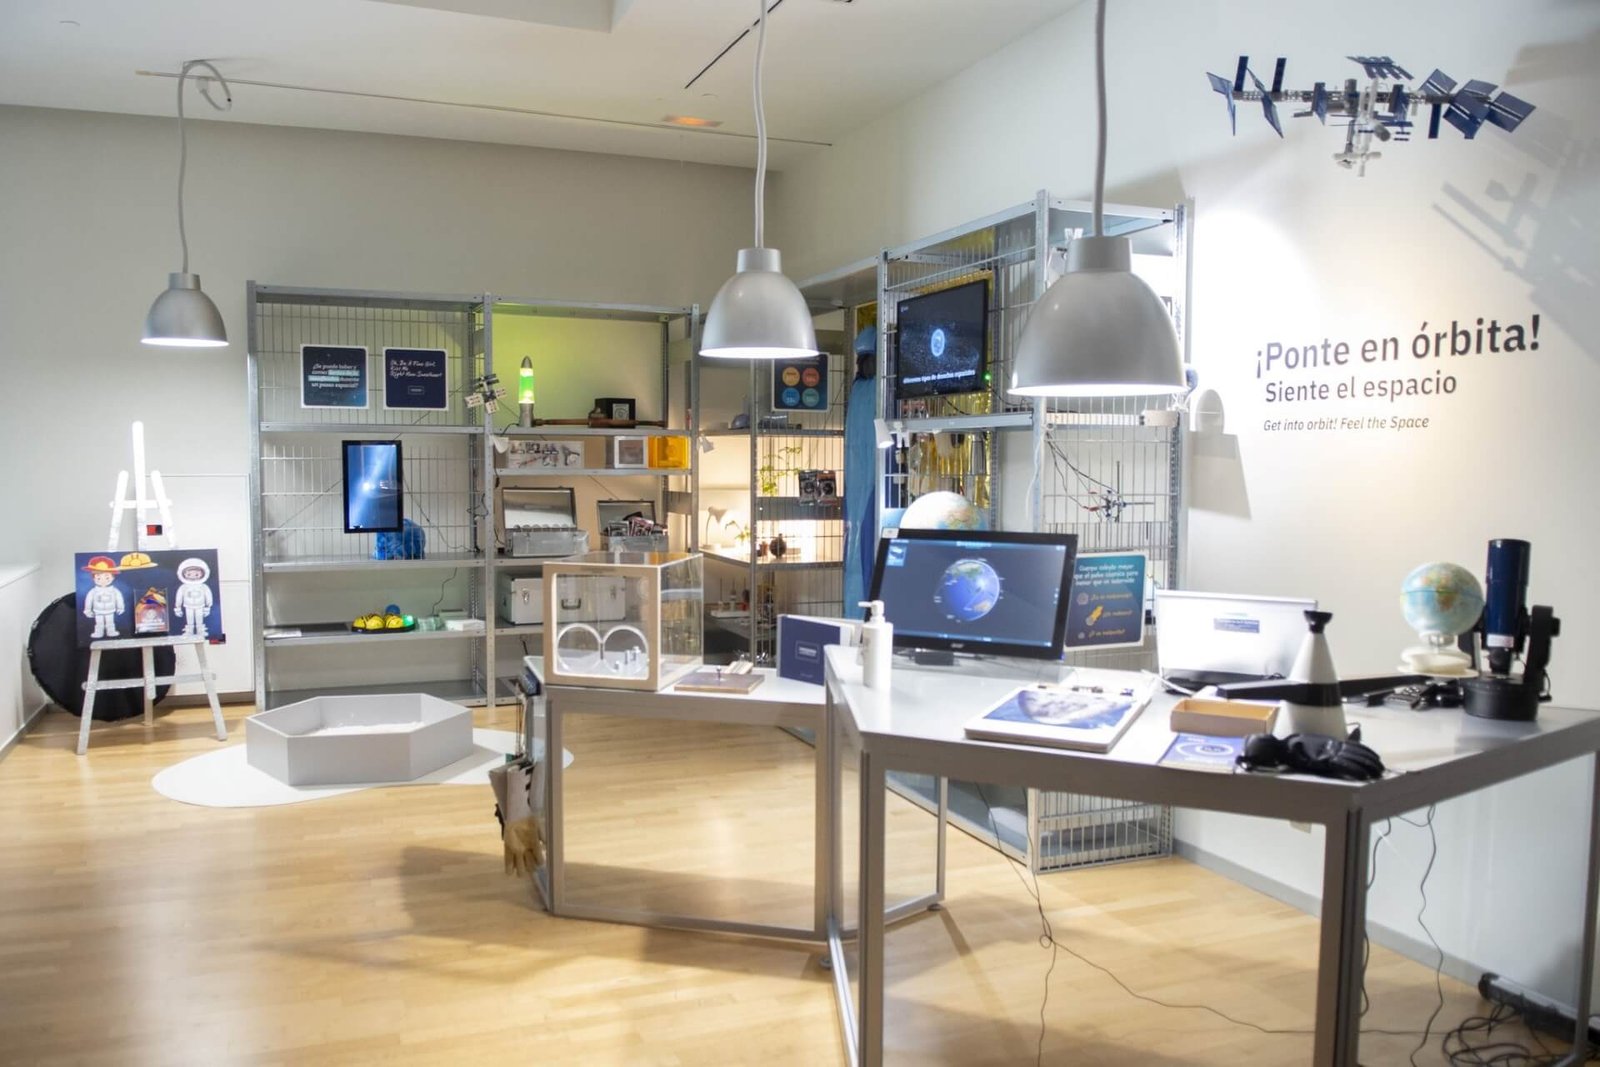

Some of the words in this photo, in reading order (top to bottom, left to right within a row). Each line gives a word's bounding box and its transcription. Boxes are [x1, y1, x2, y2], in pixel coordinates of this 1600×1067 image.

[1256, 338, 1350, 379] ¡Ponte
[1361, 335, 1399, 363] en
[1412, 314, 1541, 359] órbita!
[1265, 381, 1330, 402] Siente
[1337, 376, 1356, 399] el
[1363, 370, 1457, 403] espacio
[1263, 419, 1281, 431] Get
[1284, 418, 1304, 431] into
[1307, 417, 1338, 430] orbit!
[1340, 416, 1364, 430] Feel
[1367, 416, 1387, 430] the
[1390, 415, 1430, 432] Space
